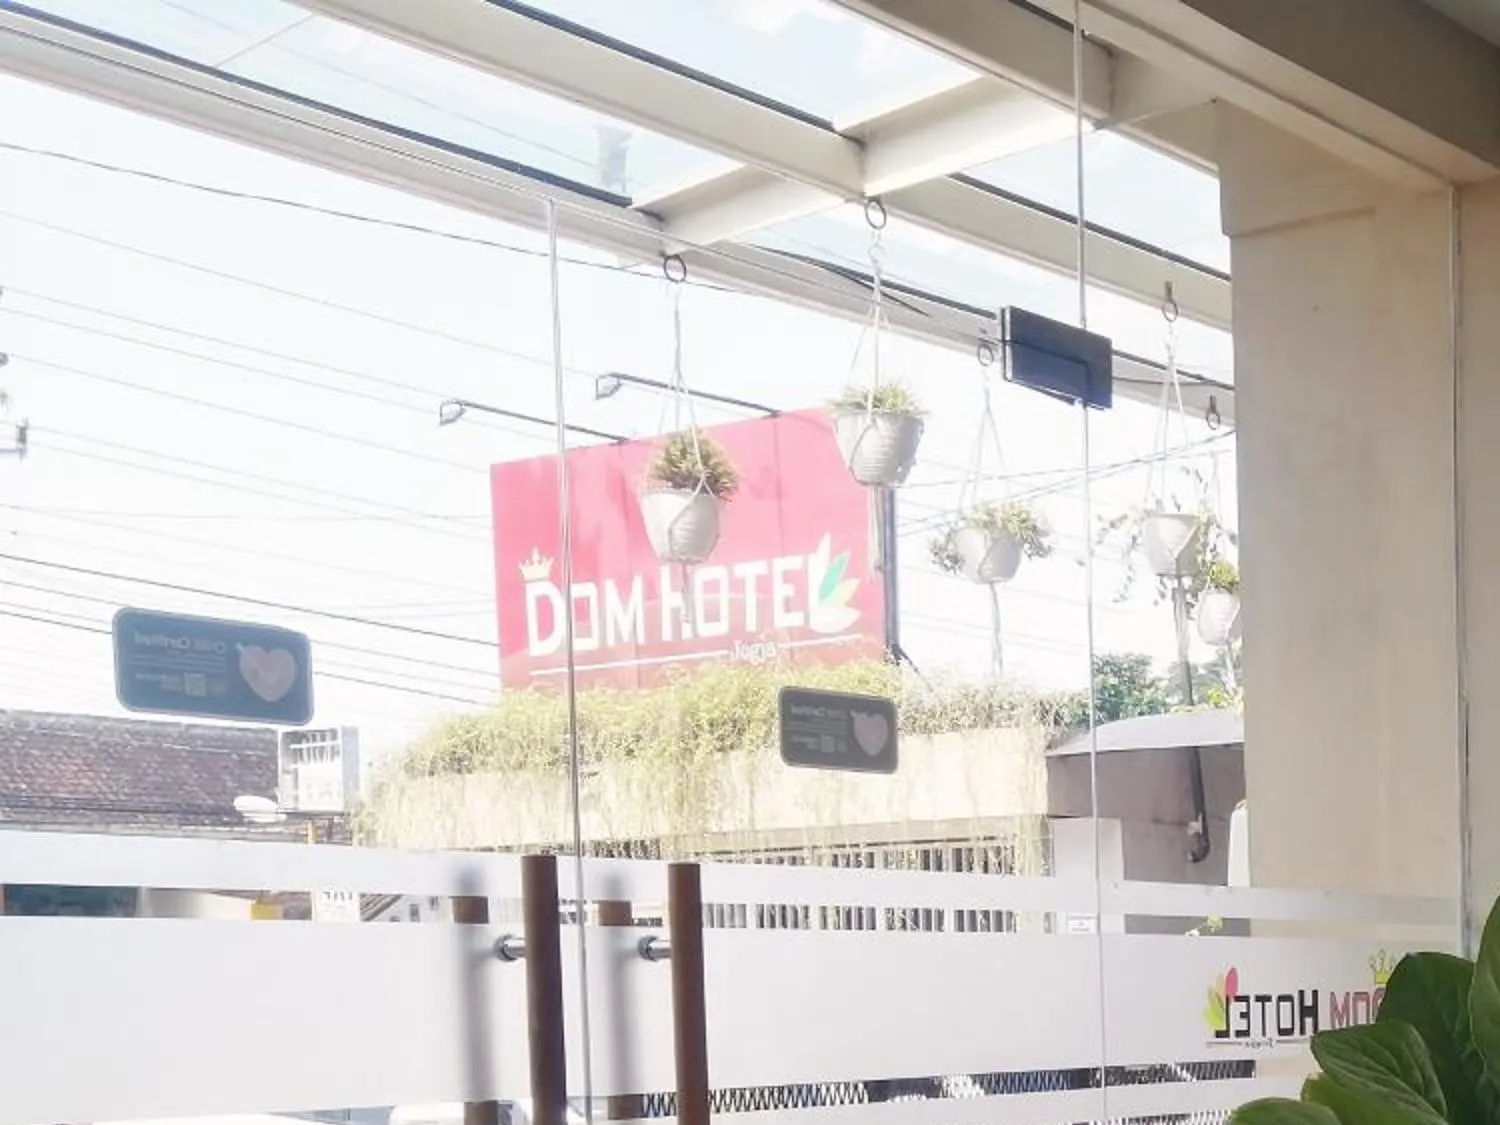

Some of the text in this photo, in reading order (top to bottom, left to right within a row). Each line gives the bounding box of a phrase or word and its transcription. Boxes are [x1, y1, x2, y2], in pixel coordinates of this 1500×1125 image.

[526, 550, 850, 657] DOM HOTEL
[730, 639, 776, 665] Jogja
